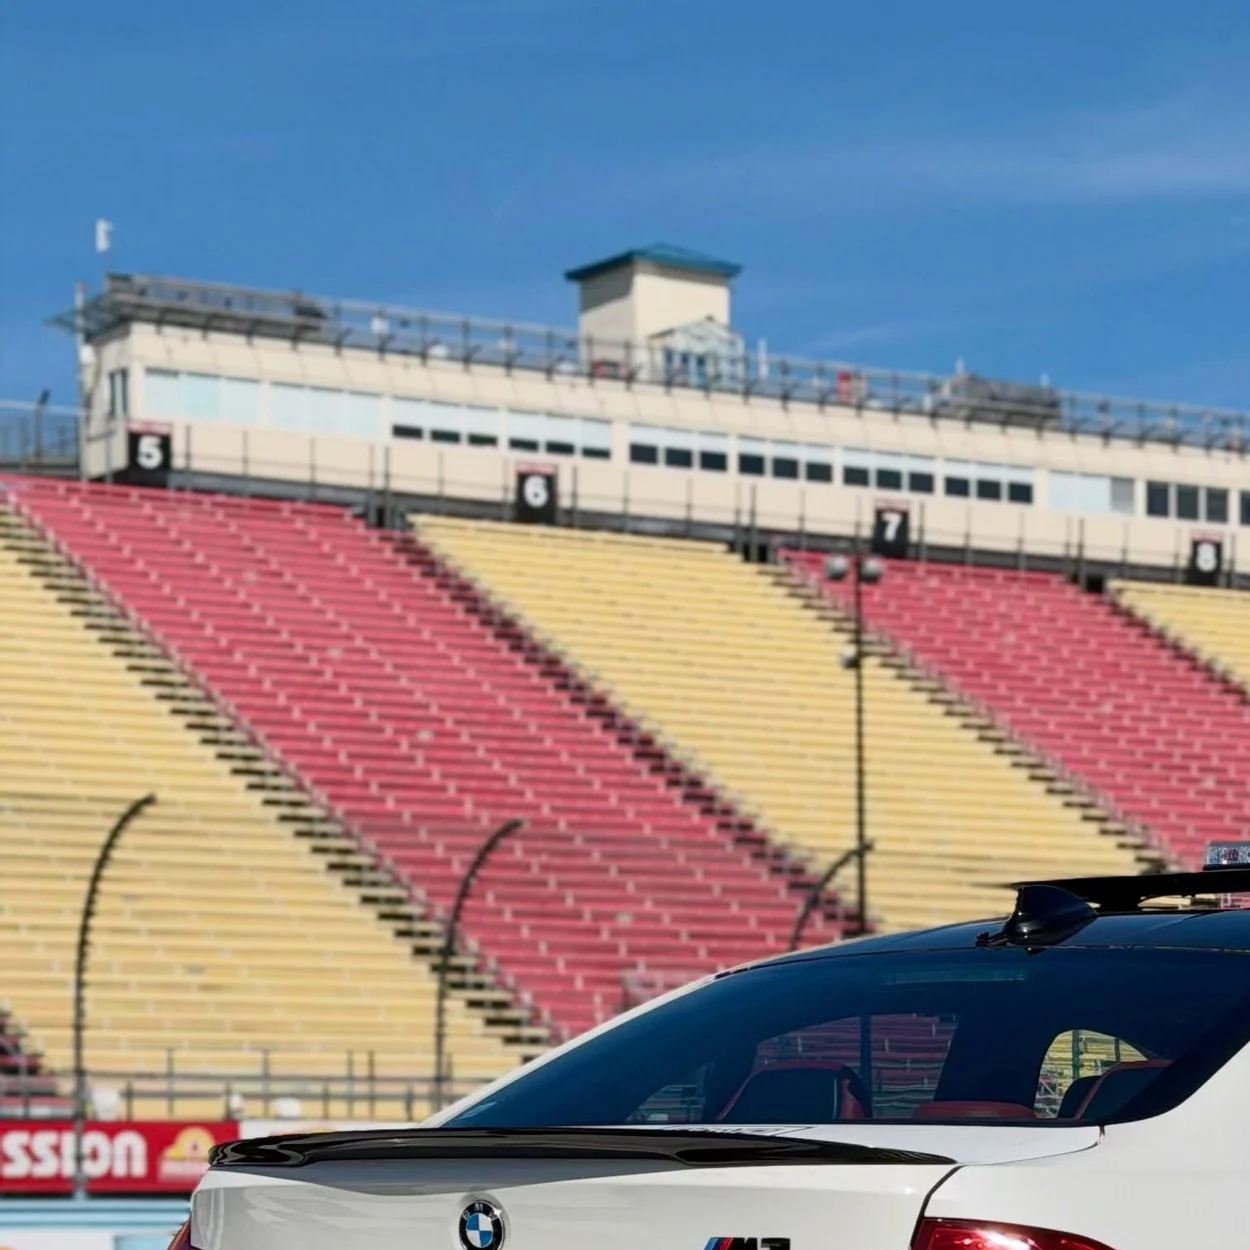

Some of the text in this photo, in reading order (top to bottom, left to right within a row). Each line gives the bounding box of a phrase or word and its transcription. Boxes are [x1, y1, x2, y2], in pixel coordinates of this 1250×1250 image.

[138, 435, 162, 468] 5
[524, 474, 550, 506] 6
[882, 508, 903, 541] 7
[1194, 538, 1218, 573] 8
